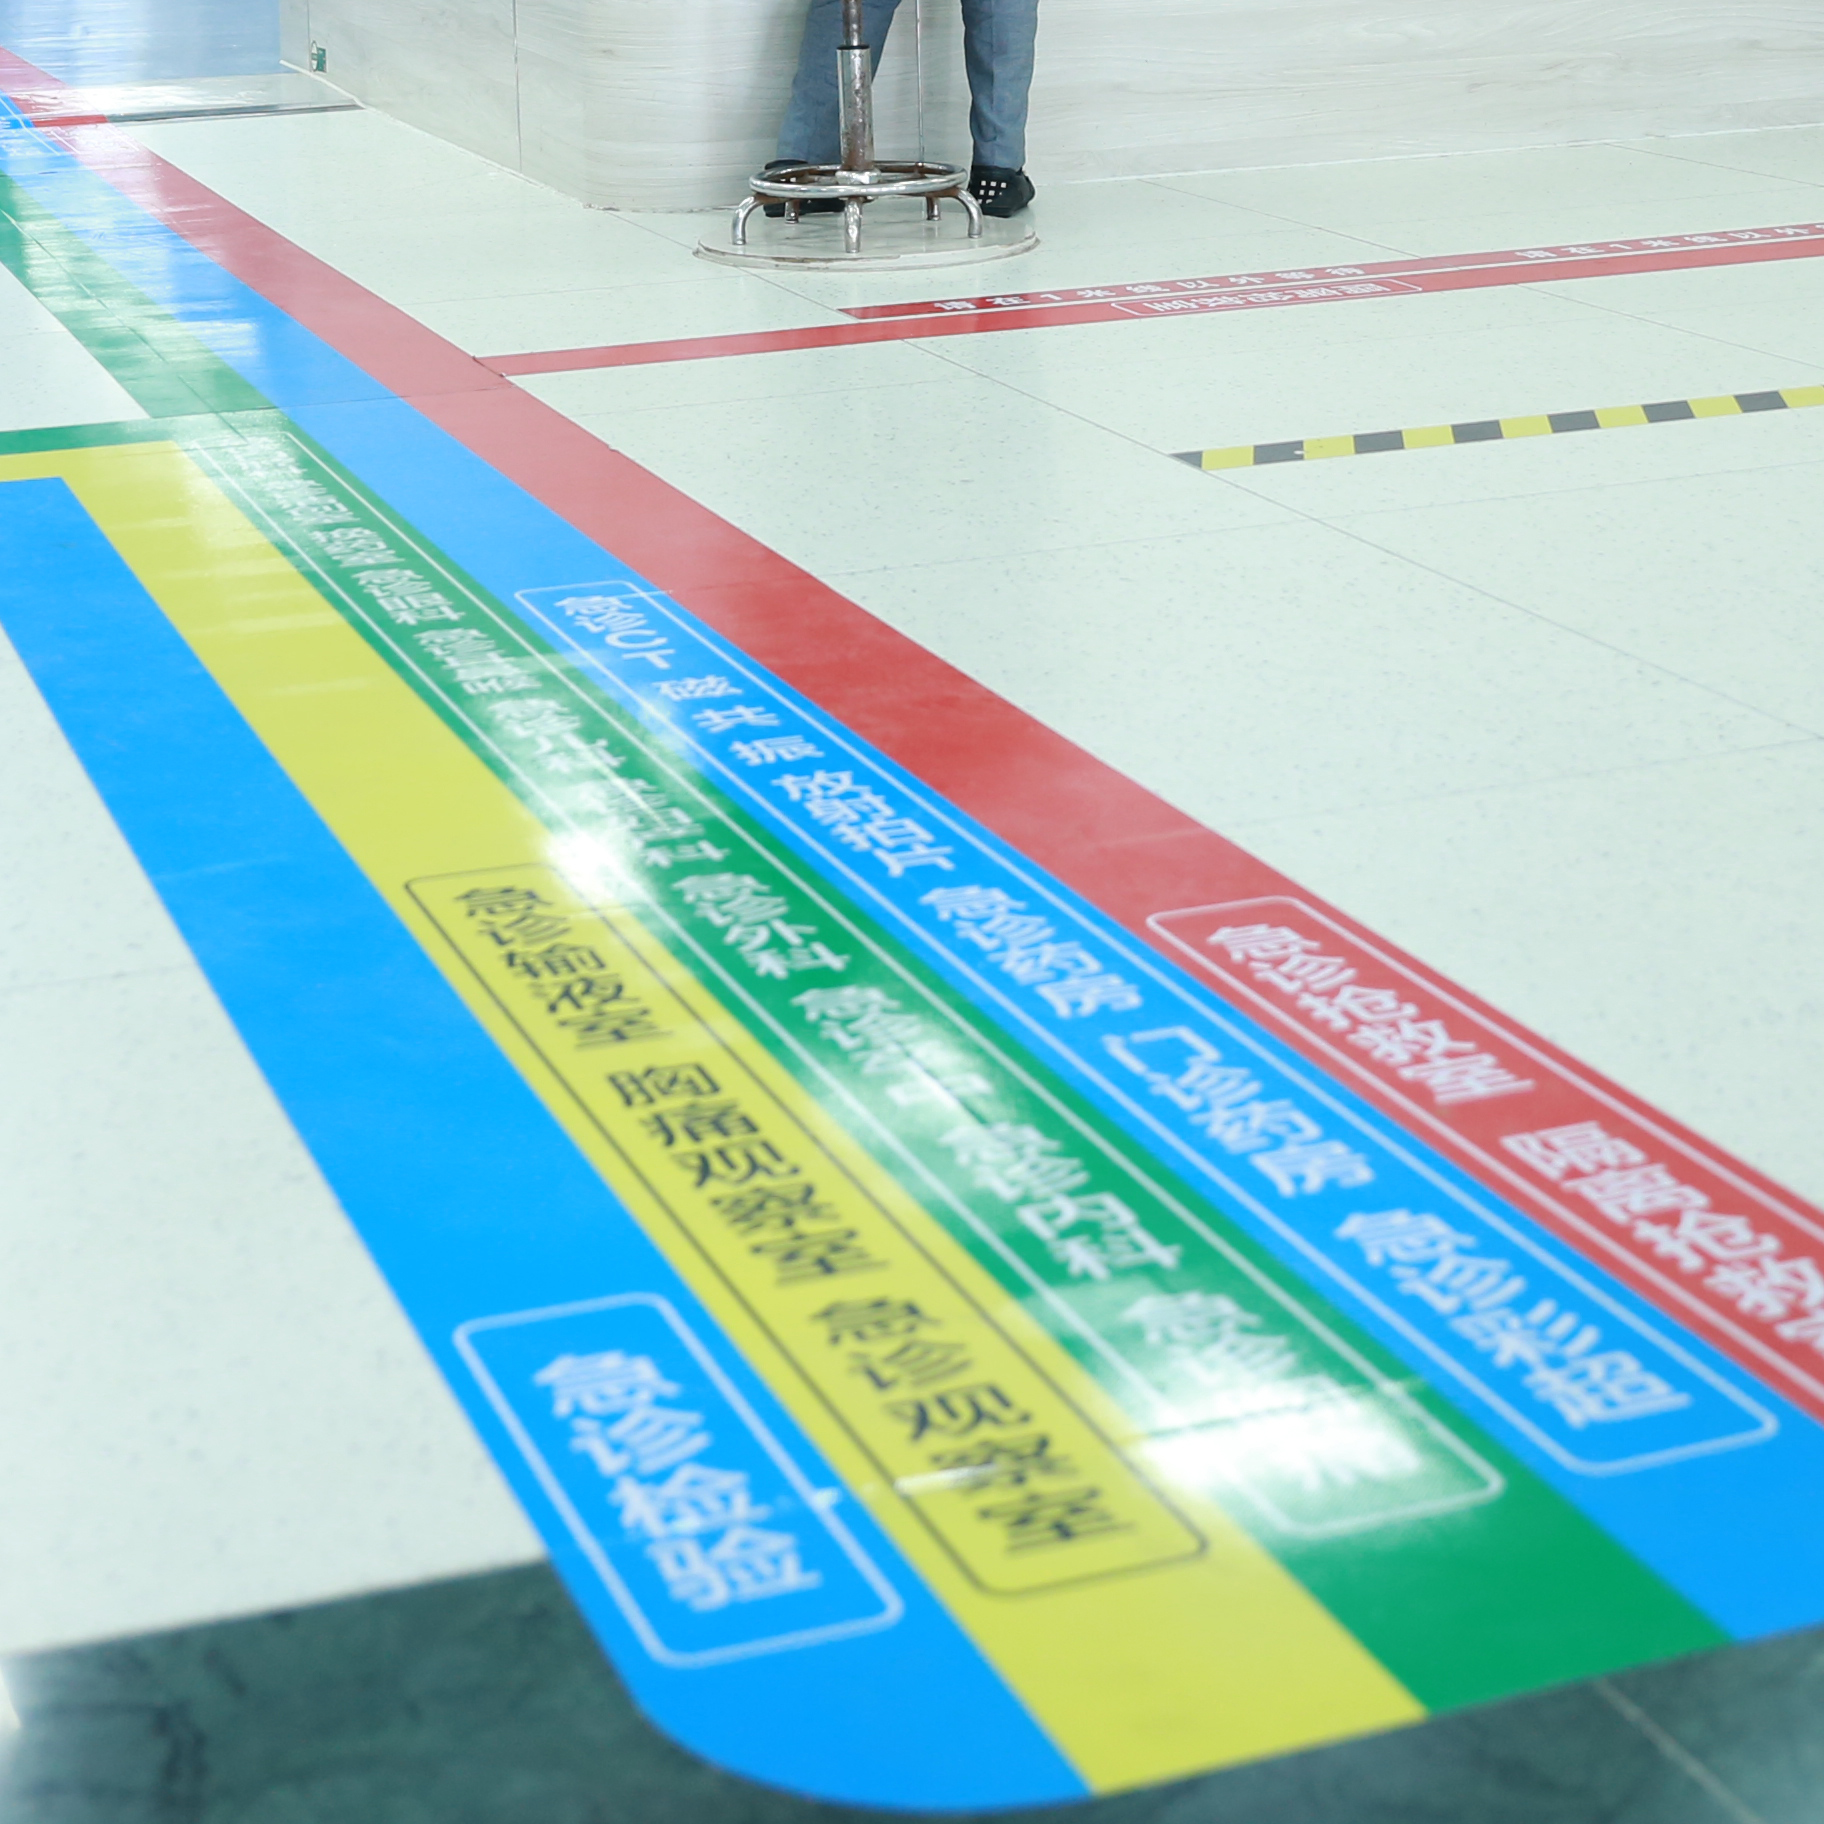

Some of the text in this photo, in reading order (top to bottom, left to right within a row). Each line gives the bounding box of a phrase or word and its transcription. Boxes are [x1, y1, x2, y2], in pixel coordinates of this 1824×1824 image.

[934, 267, 1365, 311] 请在1米线以外等待
[554, 592, 676, 670] 急诊CT
[772, 770, 958, 878] 放射拍片
[919, 882, 1143, 1019] 急诊药房
[1102, 1024, 1372, 1196] 门诊药房
[1334, 1207, 1694, 1430] 急诊彩超
[675, 870, 850, 979] 急诊外科
[939, 1121, 1181, 1280] 急诊内科
[1207, 922, 1536, 1106] 急诊抢救室
[453, 886, 1139, 1558] 急诊输液室 胸痛观察室 急诊观察室
[532, 1350, 824, 1612] 急诊检验
